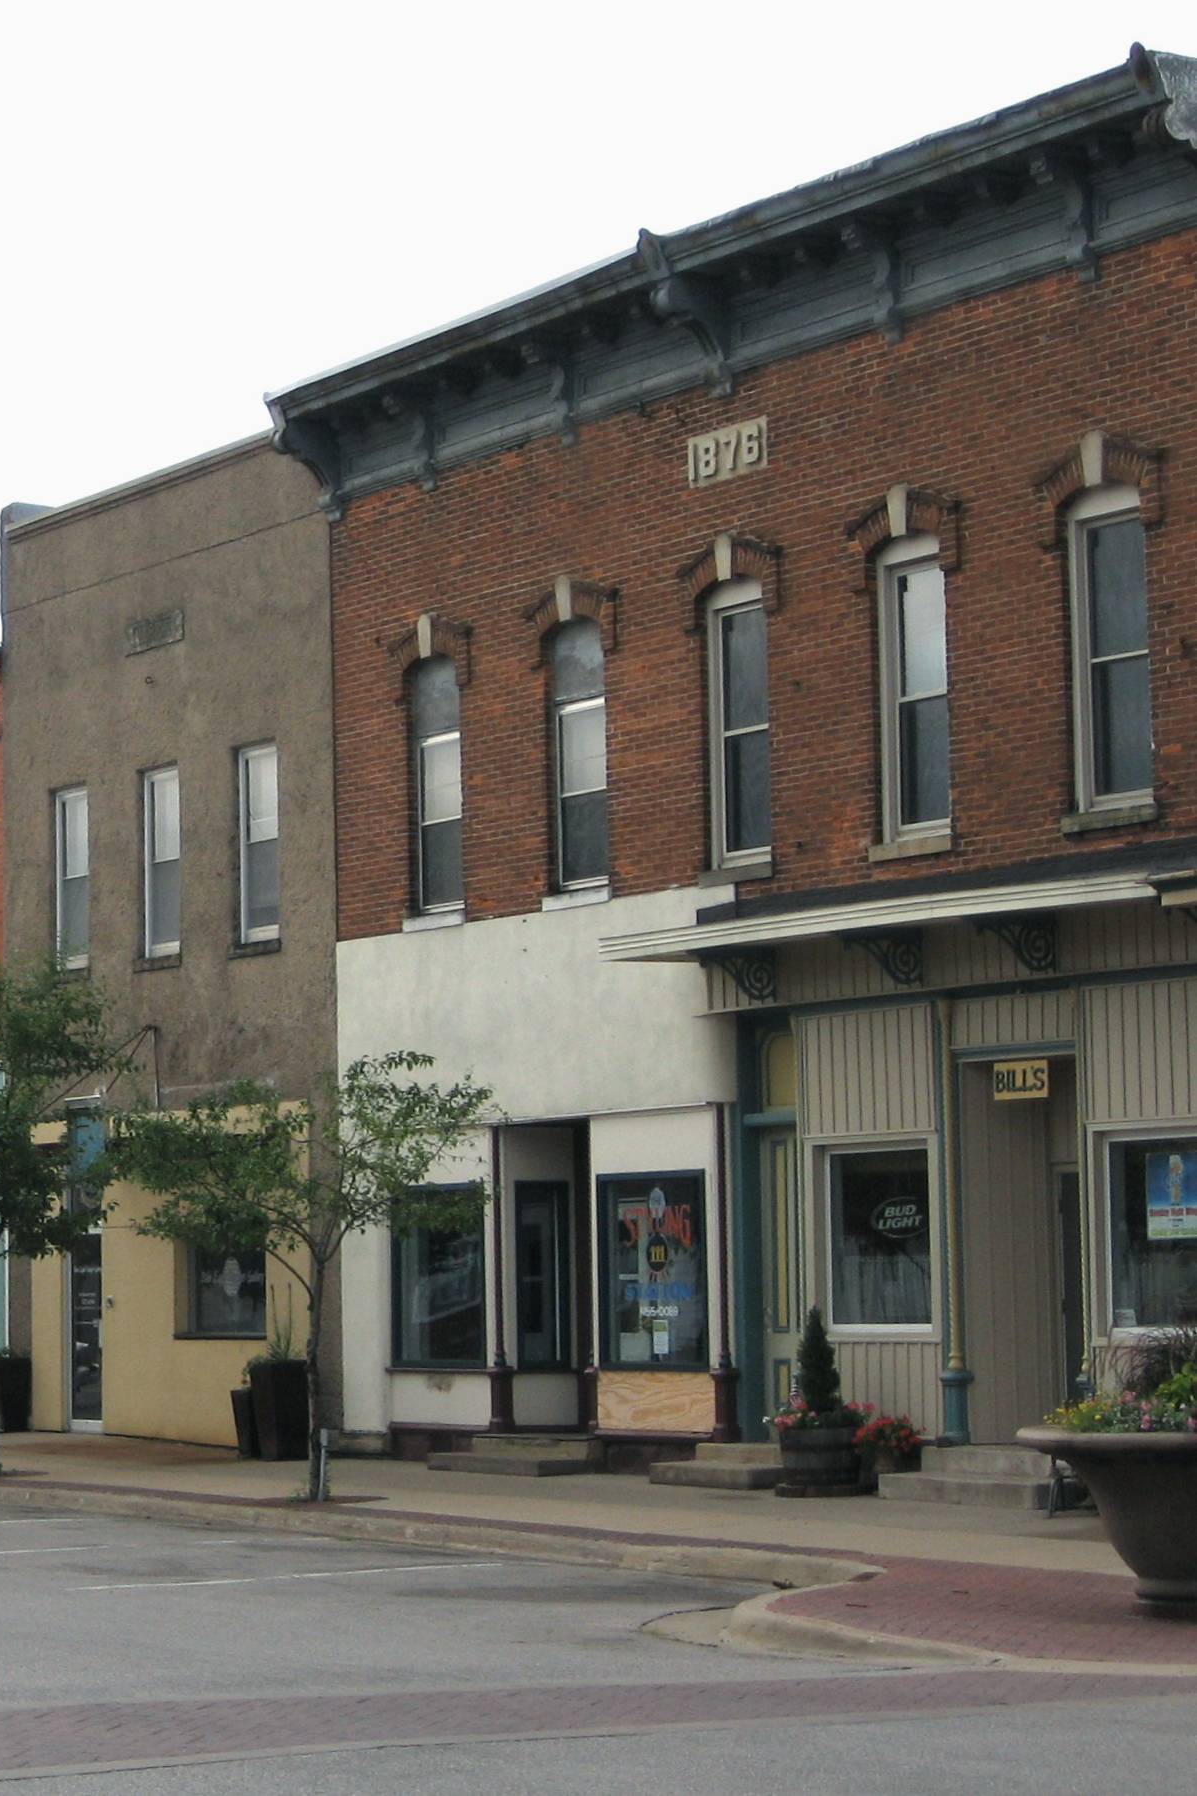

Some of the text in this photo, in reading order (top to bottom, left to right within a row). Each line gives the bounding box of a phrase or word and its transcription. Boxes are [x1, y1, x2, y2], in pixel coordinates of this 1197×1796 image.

[688, 424, 761, 482] 1876
[995, 1065, 1045, 1093] BILL'S
[877, 1215, 923, 1230] LIGHT
[884, 1205, 917, 1218] BUD
[622, 1204, 691, 1248] STYLING
